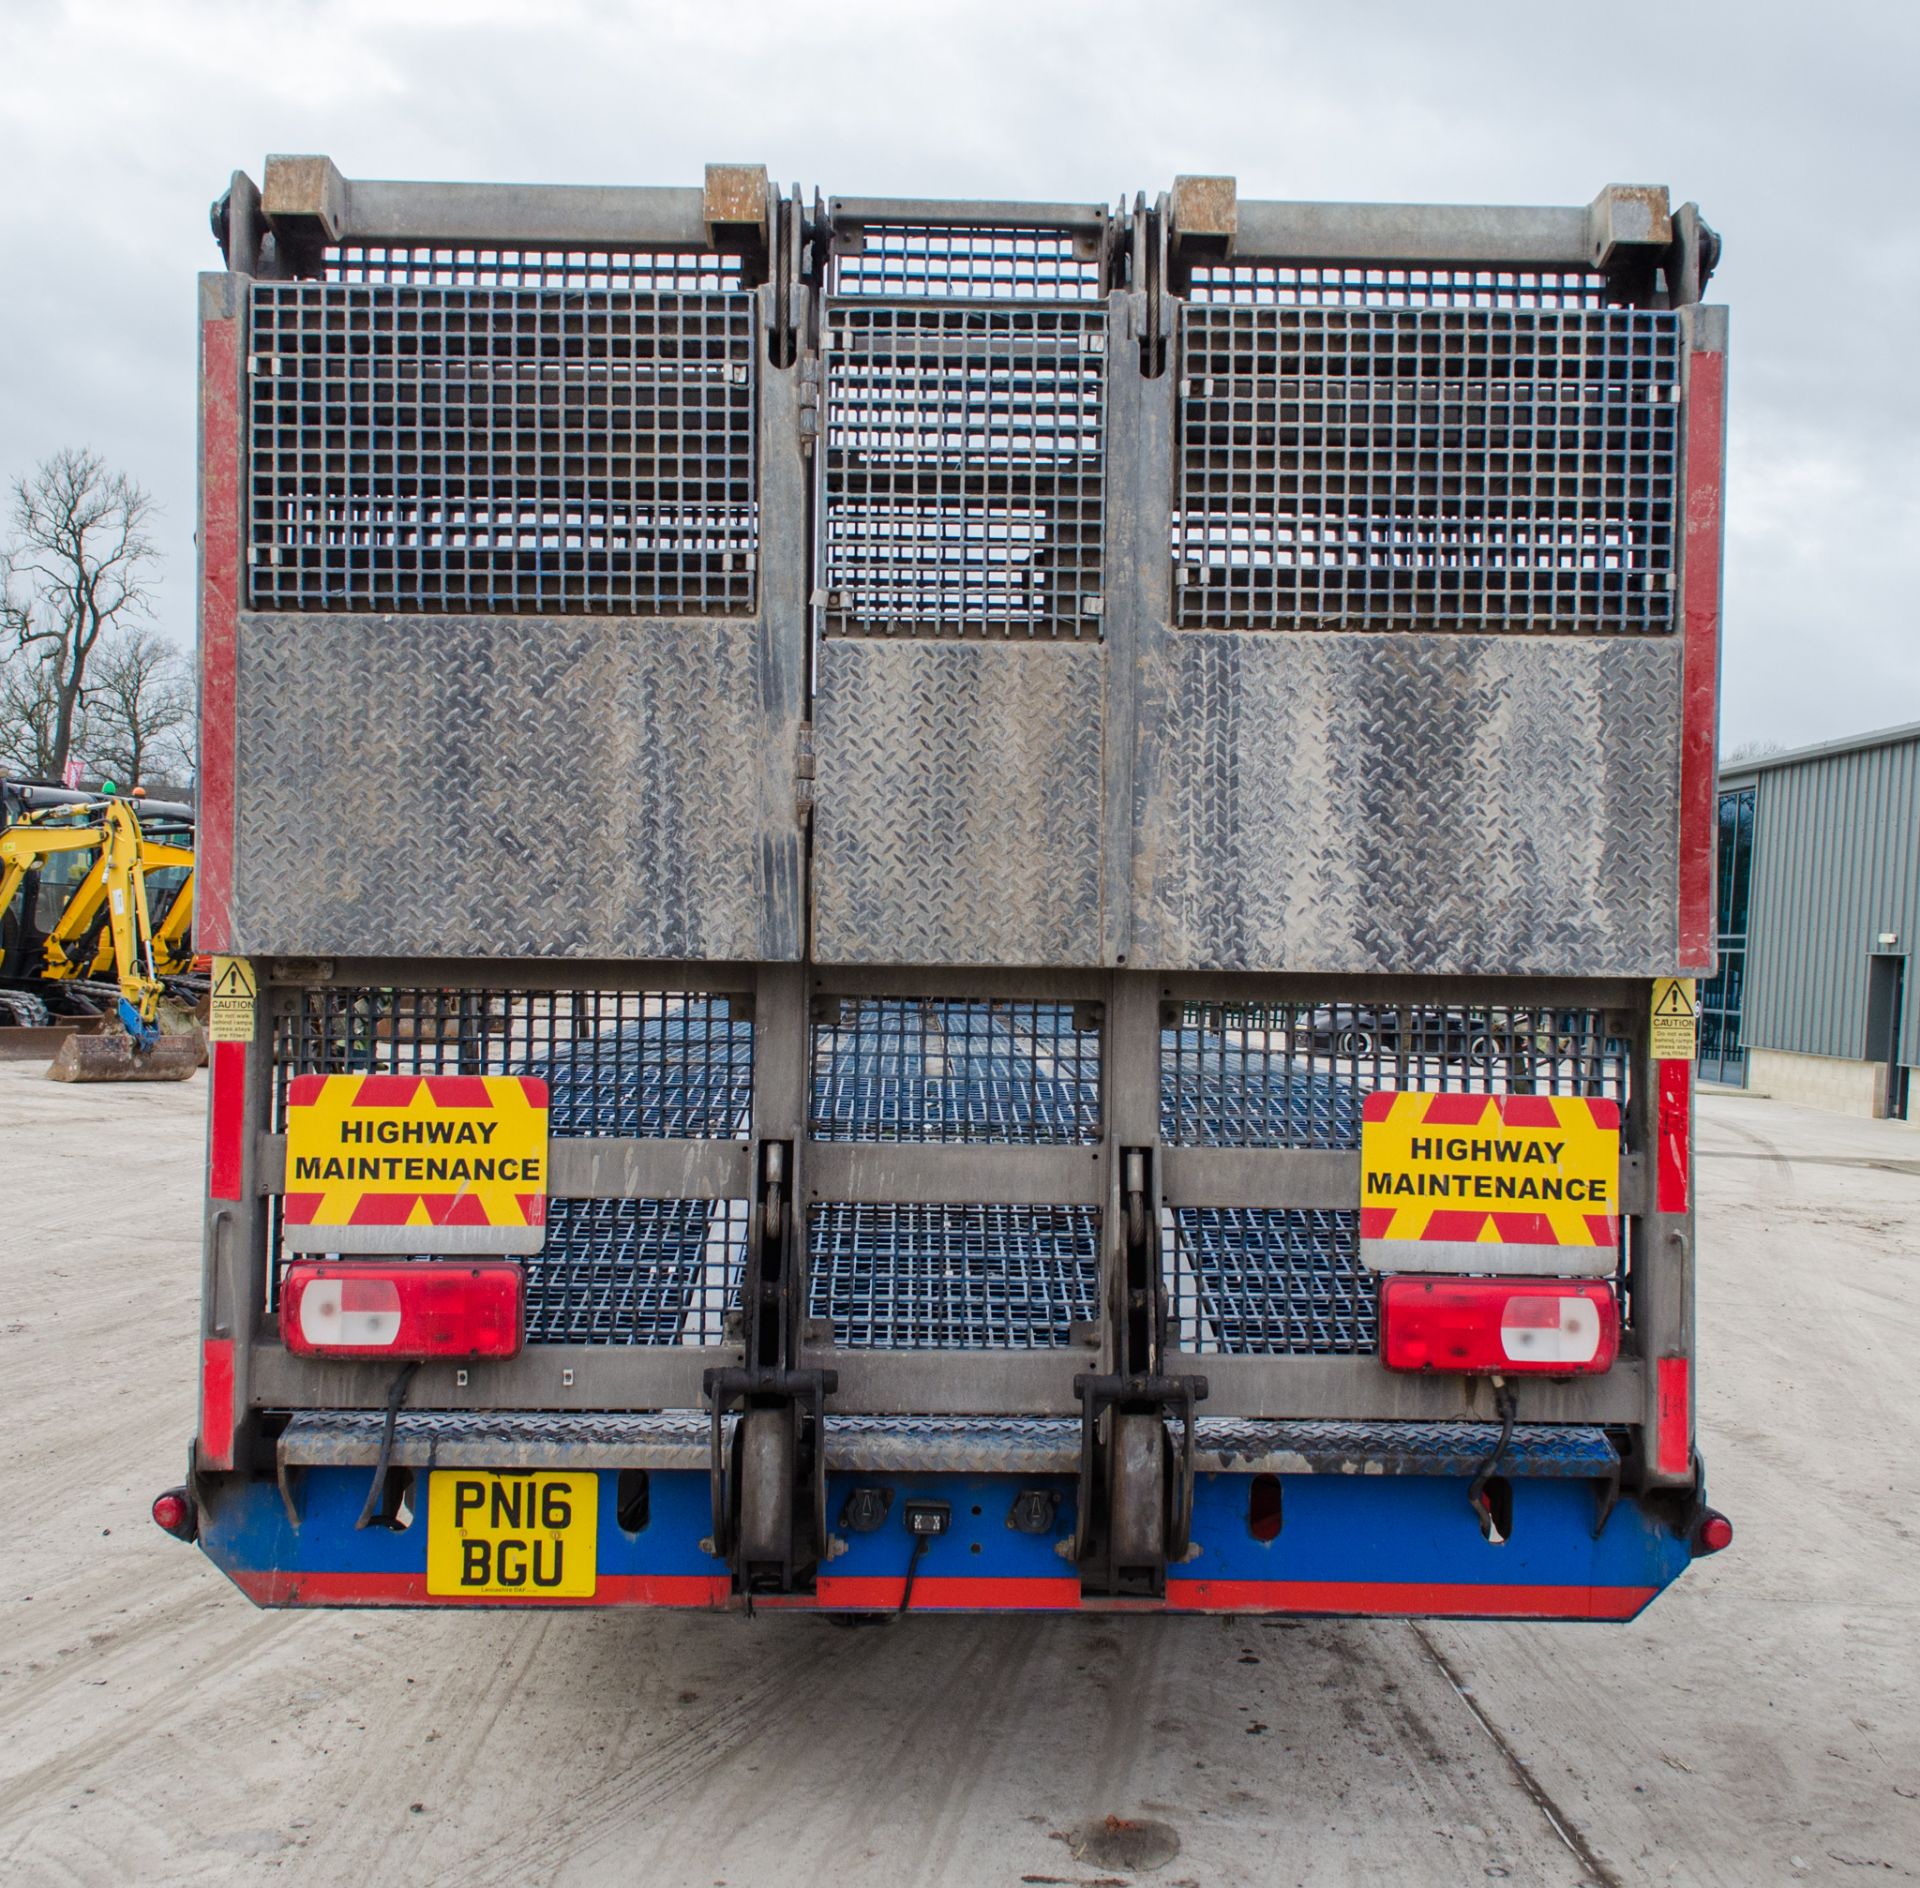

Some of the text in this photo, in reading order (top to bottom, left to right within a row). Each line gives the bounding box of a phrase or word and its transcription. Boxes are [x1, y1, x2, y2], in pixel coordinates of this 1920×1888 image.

[212, 1000, 254, 1009] CAUTION
[1653, 1018, 1694, 1027] CAUTION
[341, 1120, 499, 1145] HIGHWAY
[1410, 1137, 1565, 1164] HIGHWAY
[295, 1156, 541, 1182] MAINTENANCE
[1366, 1171, 1607, 1202] MAINTENANCE
[455, 1480, 573, 1530] PN16
[460, 1538, 564, 1587] BGU
